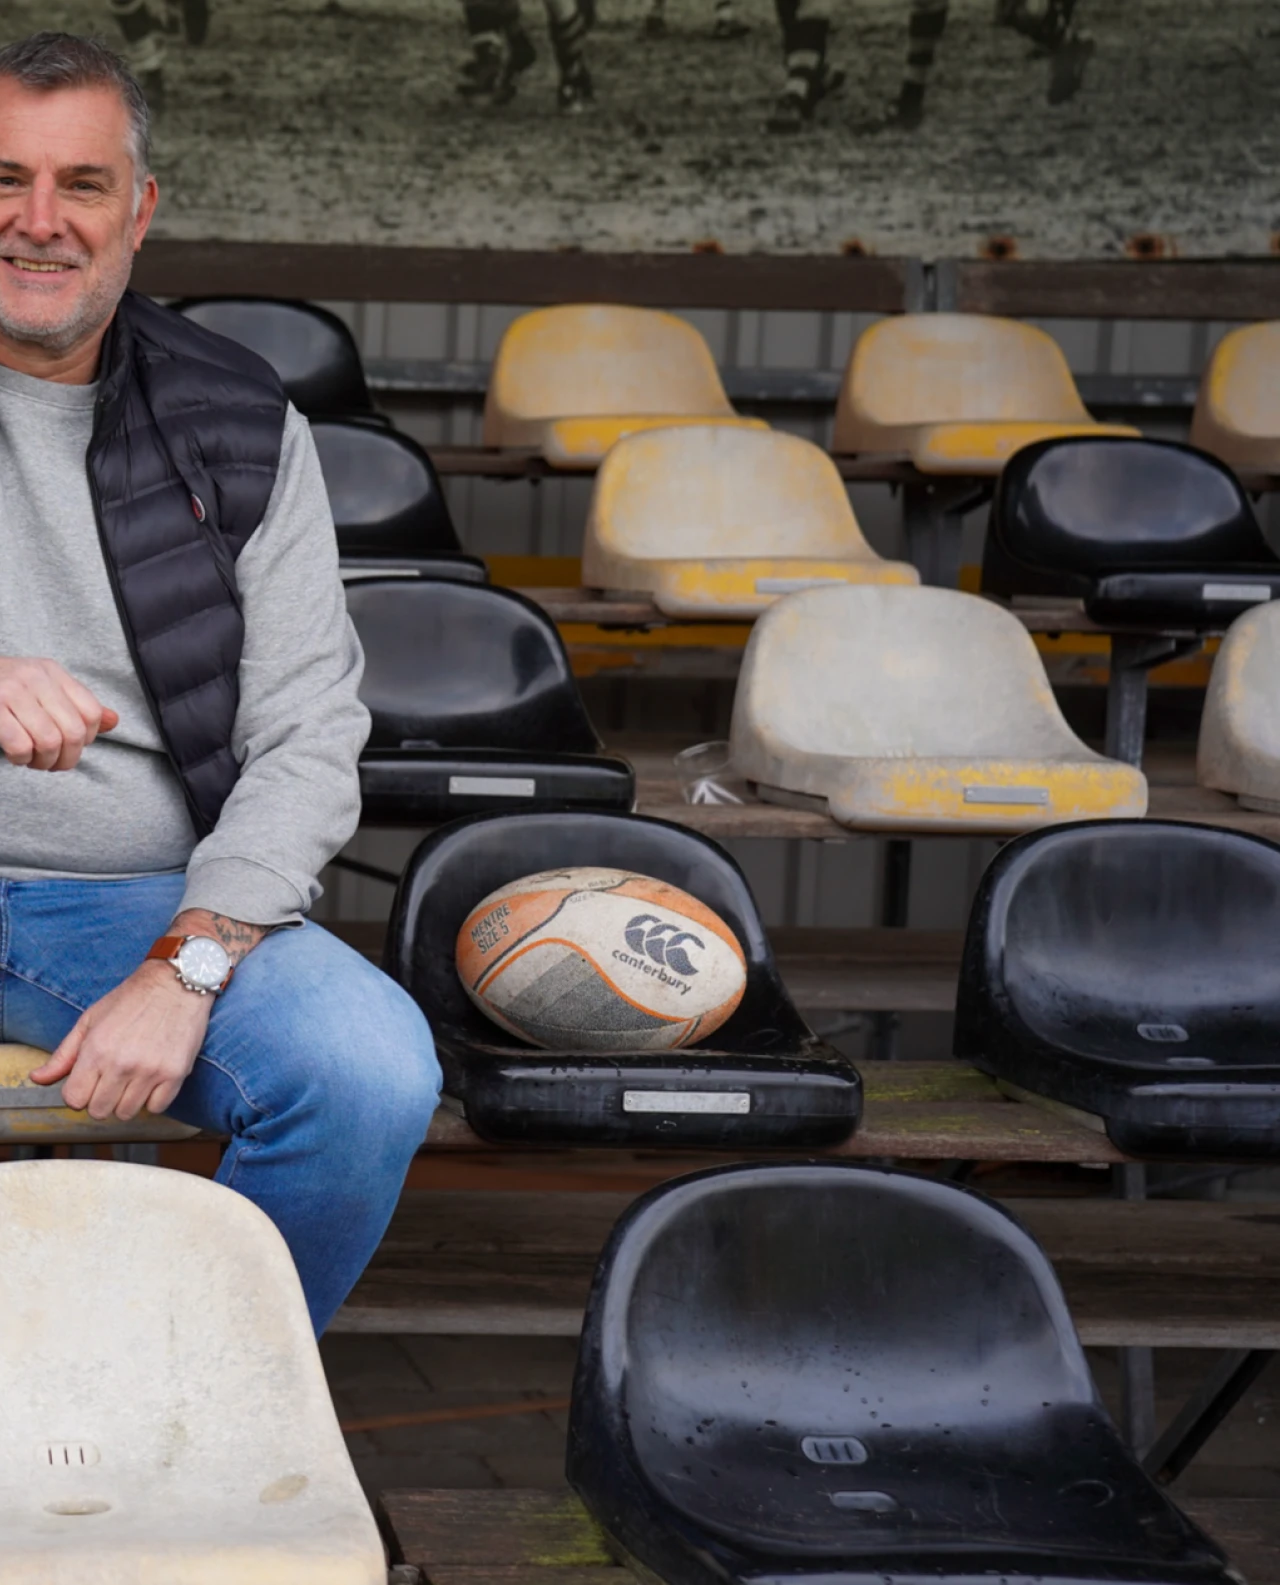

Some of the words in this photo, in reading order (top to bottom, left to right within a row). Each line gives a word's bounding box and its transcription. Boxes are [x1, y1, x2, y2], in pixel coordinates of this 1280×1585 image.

[471, 902, 511, 943] MENTRE
[477, 926, 502, 955] SIZE
[500, 920, 510, 936] 5
[612, 949, 692, 996] canterbury
